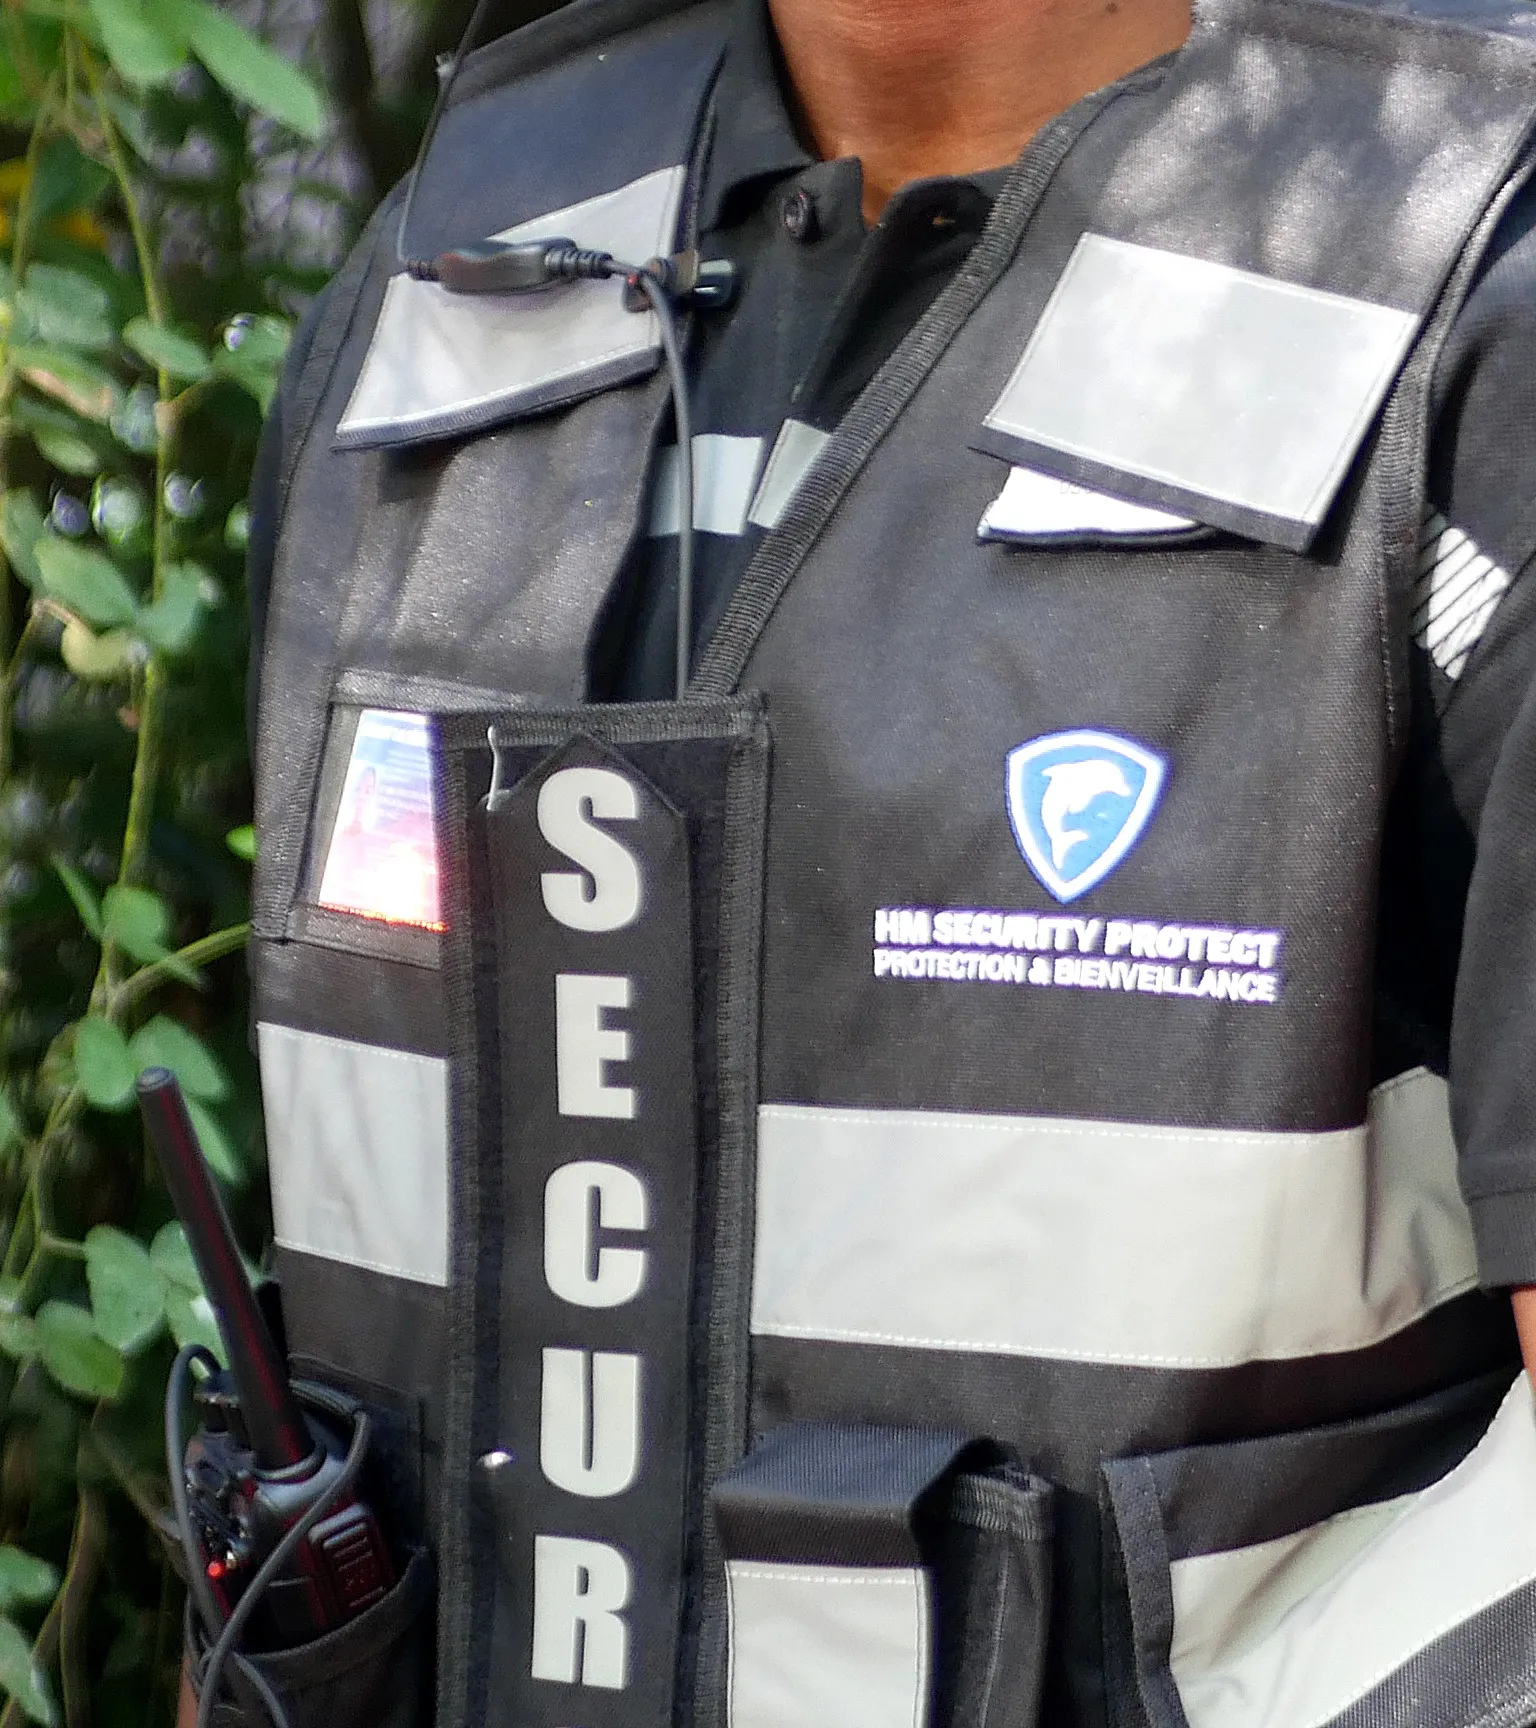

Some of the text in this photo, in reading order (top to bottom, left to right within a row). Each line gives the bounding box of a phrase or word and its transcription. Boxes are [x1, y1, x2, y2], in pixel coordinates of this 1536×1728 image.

[874, 909, 1280, 969] HM SECURITY PROTECT
[873, 948, 1278, 1004] PROTECTION & BIENVEILLANCE
[530, 766, 648, 1728] SECUR
